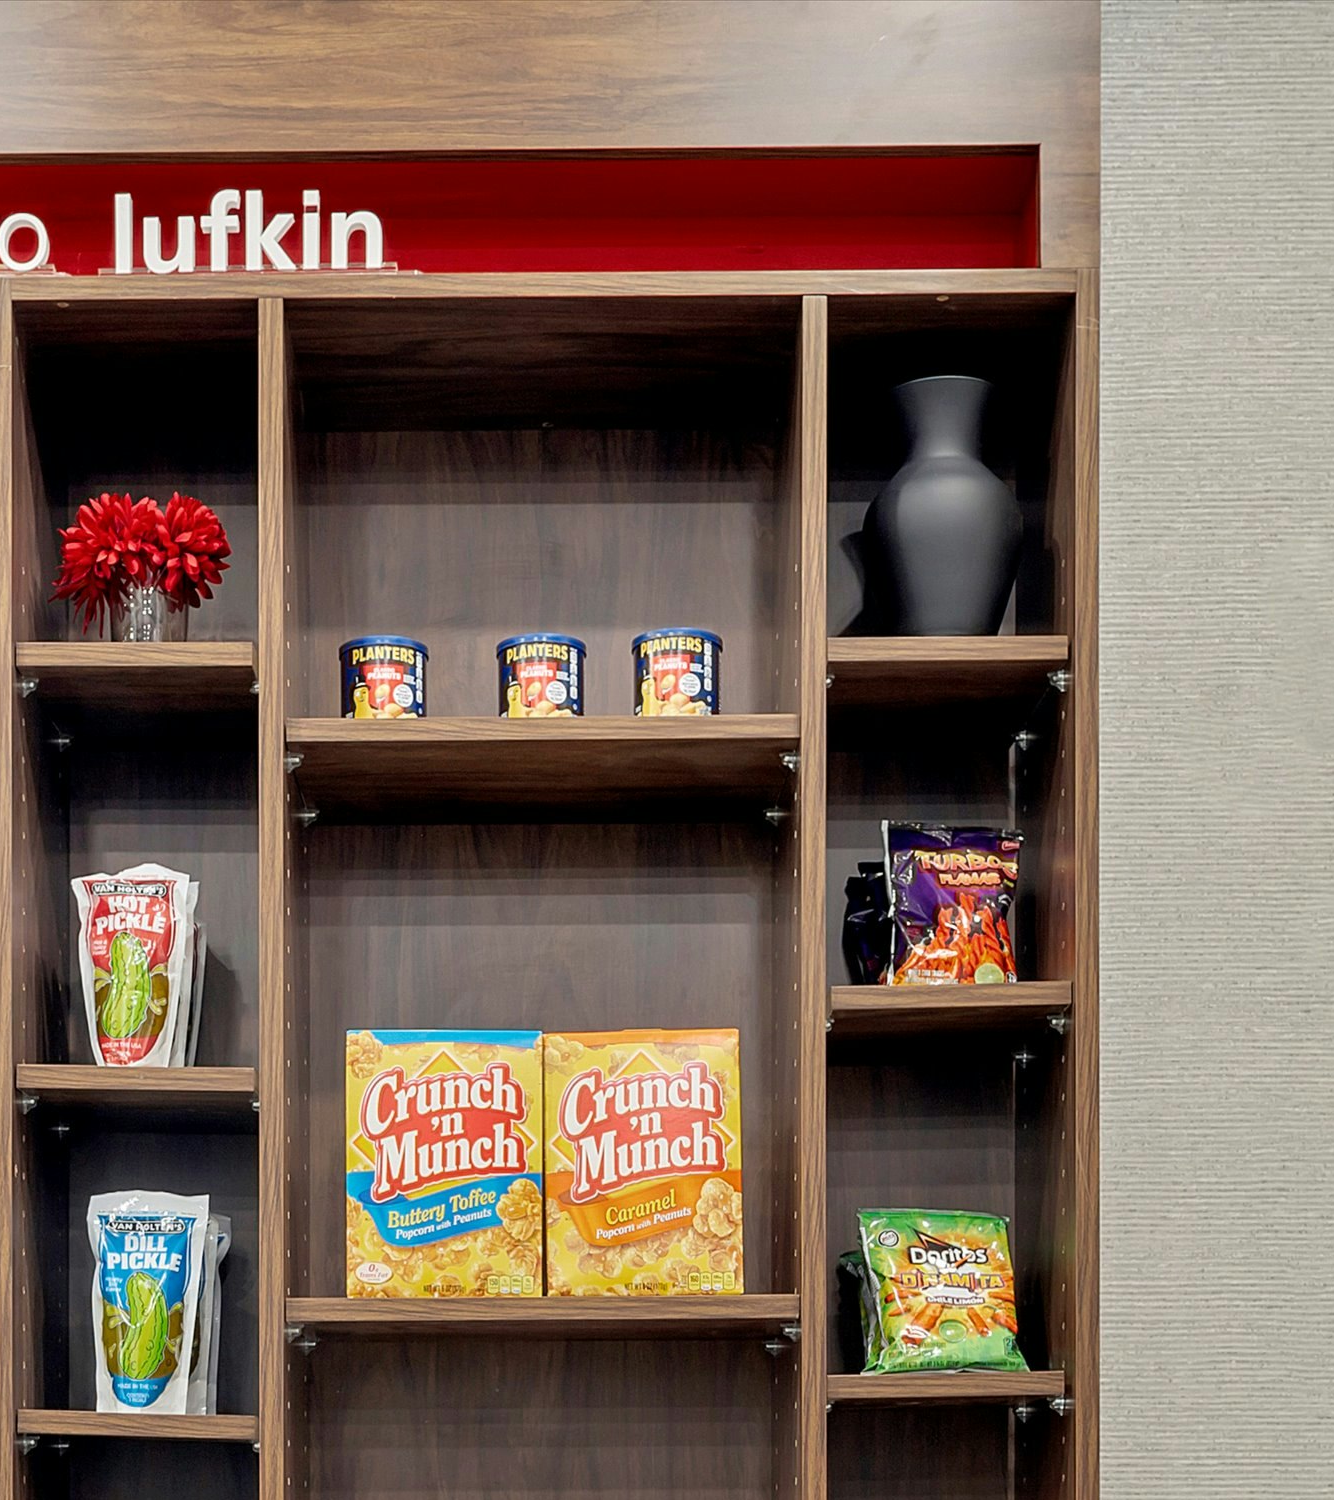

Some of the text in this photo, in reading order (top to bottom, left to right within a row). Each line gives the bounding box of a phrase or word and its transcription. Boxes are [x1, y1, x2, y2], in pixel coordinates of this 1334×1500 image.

[115, 189, 384, 275] lufkin
[352, 645, 415, 665] PLANTERS
[506, 645, 568, 665] PLANTERS
[640, 638, 702, 656] PLANTERS
[94, 884, 115, 894] VAN
[108, 896, 151, 913] HOT
[95, 912, 167, 935] PICKLE
[366, 1068, 517, 1136] Crunch
[564, 1068, 716, 1136] Crunch
[379, 1123, 519, 1194] Munch
[578, 1122, 718, 1194] Munch
[387, 1189, 496, 1229] Buttery Toffee
[605, 1189, 677, 1225] Caramel
[395, 1208, 492, 1240] Popcorn Peanuts
[596, 1207, 692, 1240] Popcorn Peanuts
[125, 1235, 168, 1251] DILL
[107, 1253, 182, 1273] PICKLE
[910, 1248, 987, 1264] Doritos
[901, 1273, 1004, 1289] DINAMITA
